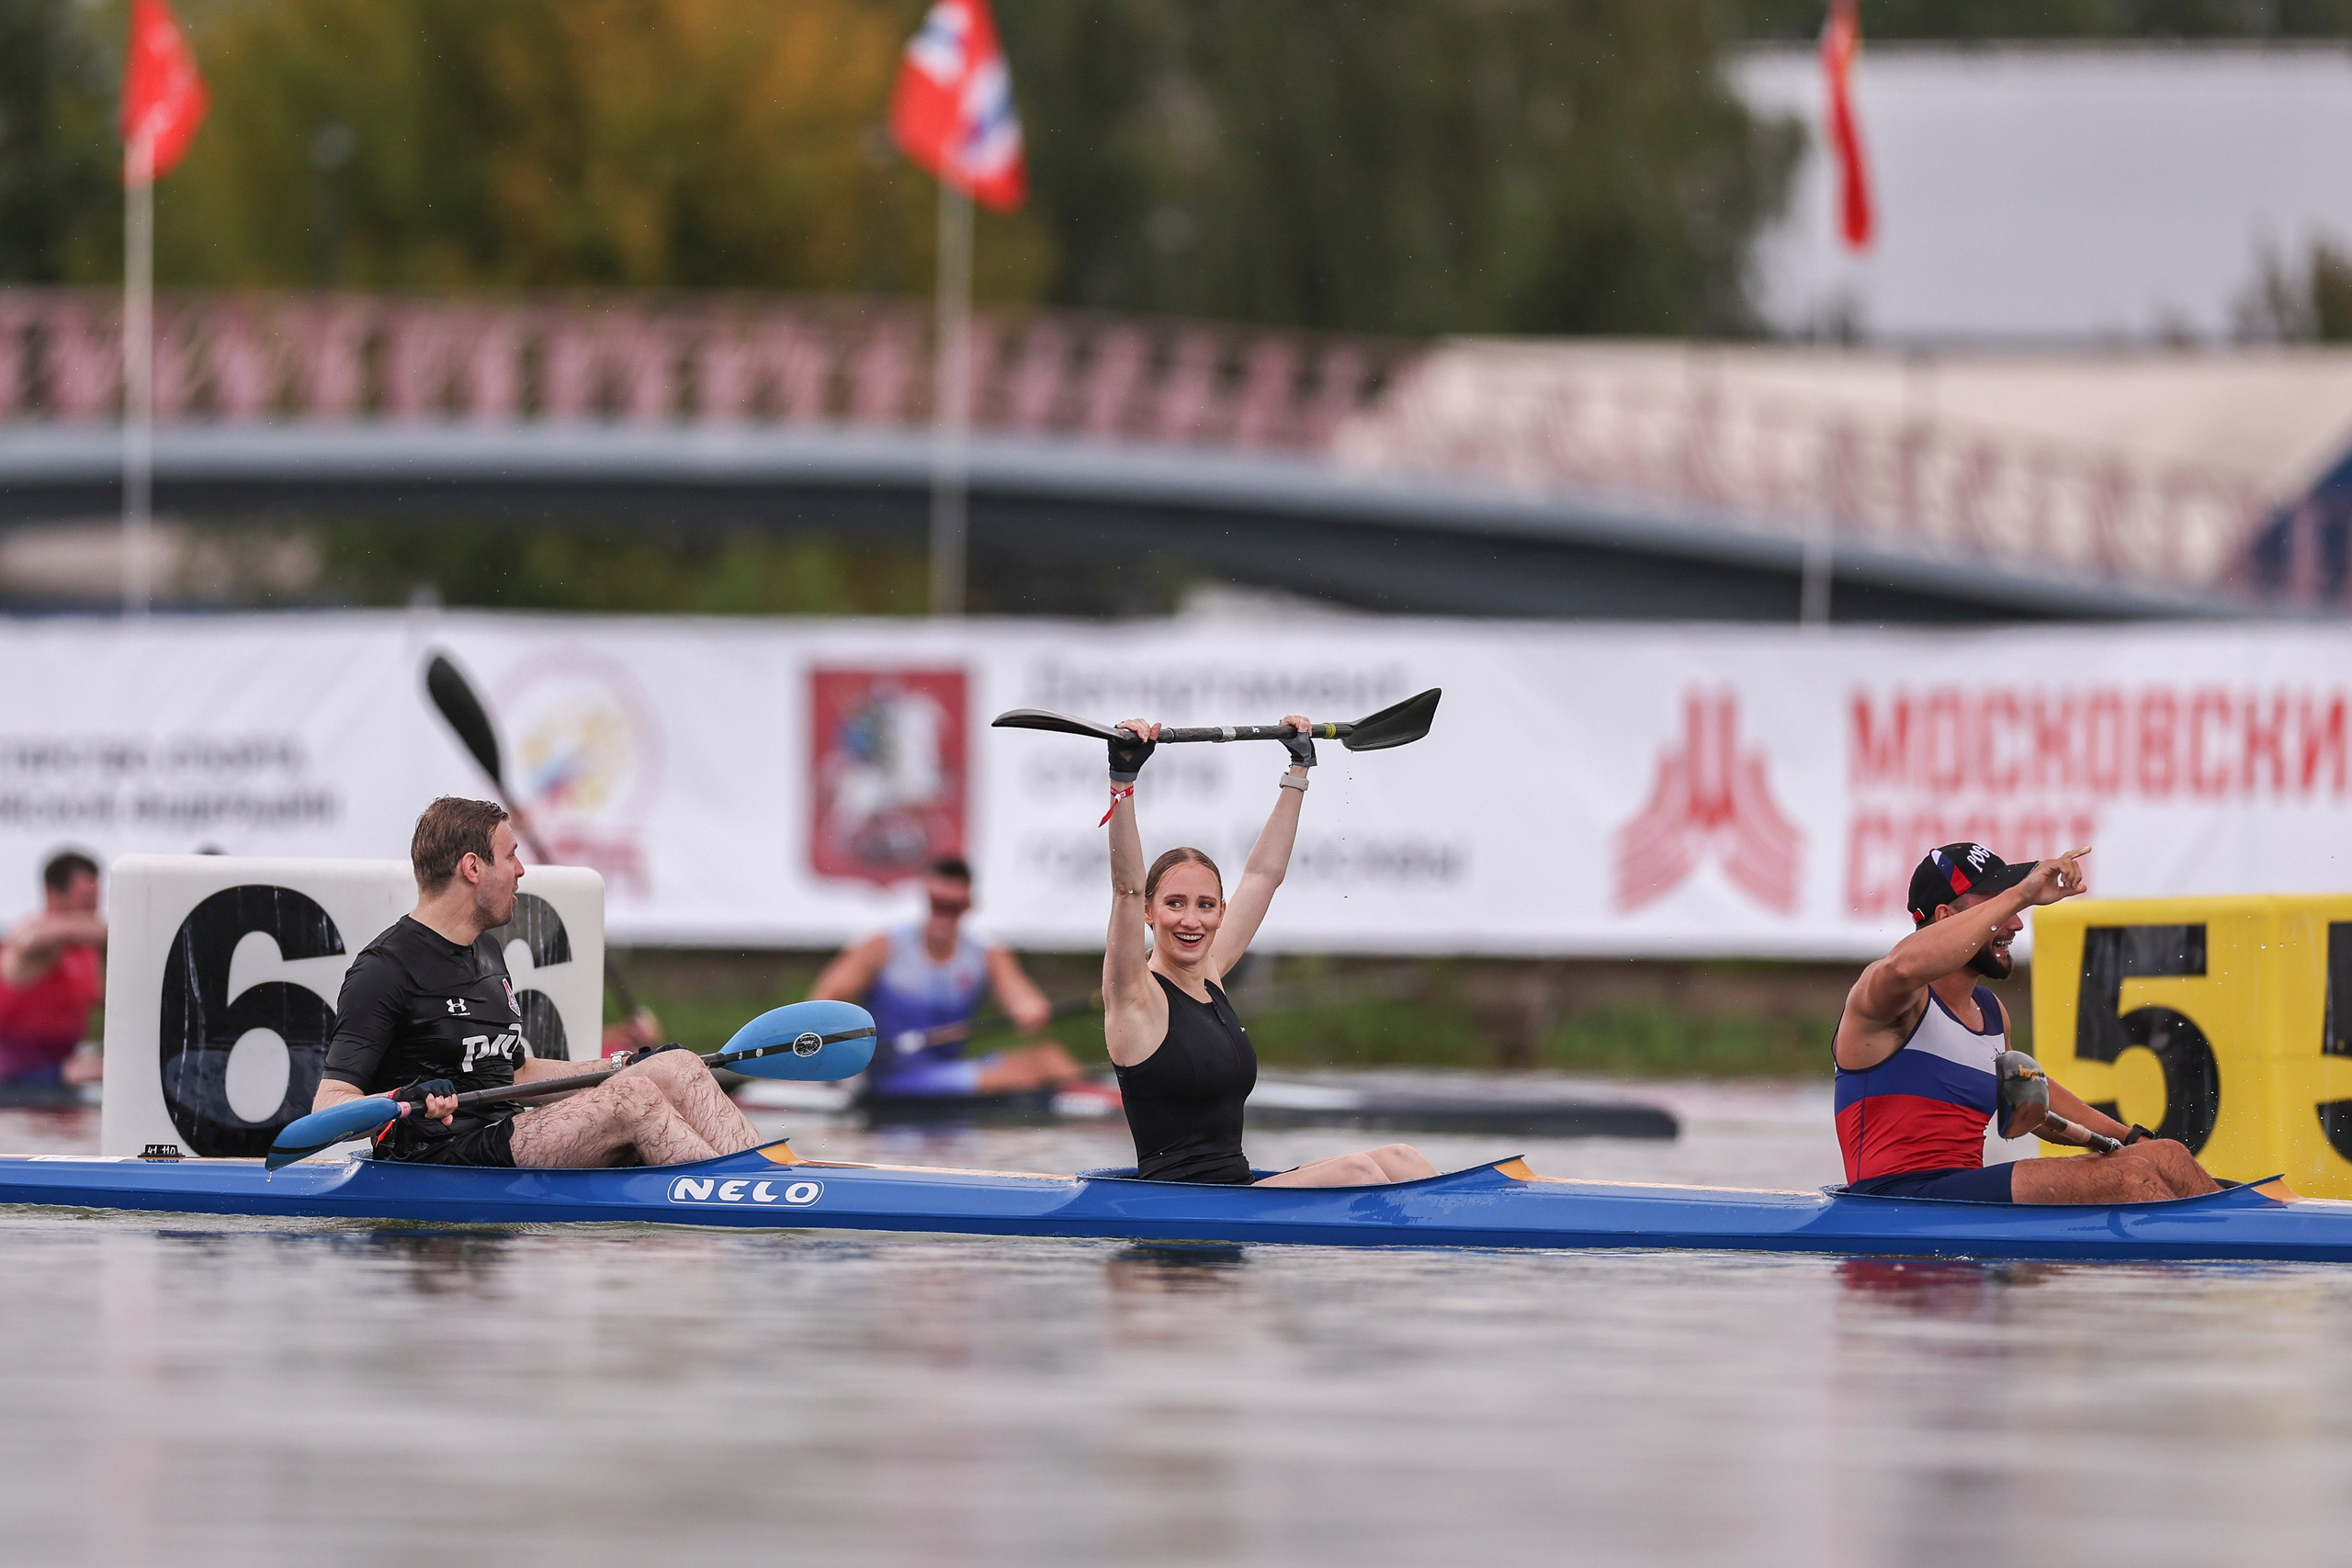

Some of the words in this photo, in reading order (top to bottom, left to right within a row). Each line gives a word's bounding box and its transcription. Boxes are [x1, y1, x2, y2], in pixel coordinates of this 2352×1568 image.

[1967, 844, 1997, 874] РОС
[160, 885, 346, 1157] 6
[2074, 921, 2221, 1159] 5
[673, 1178, 820, 1203] NELO
